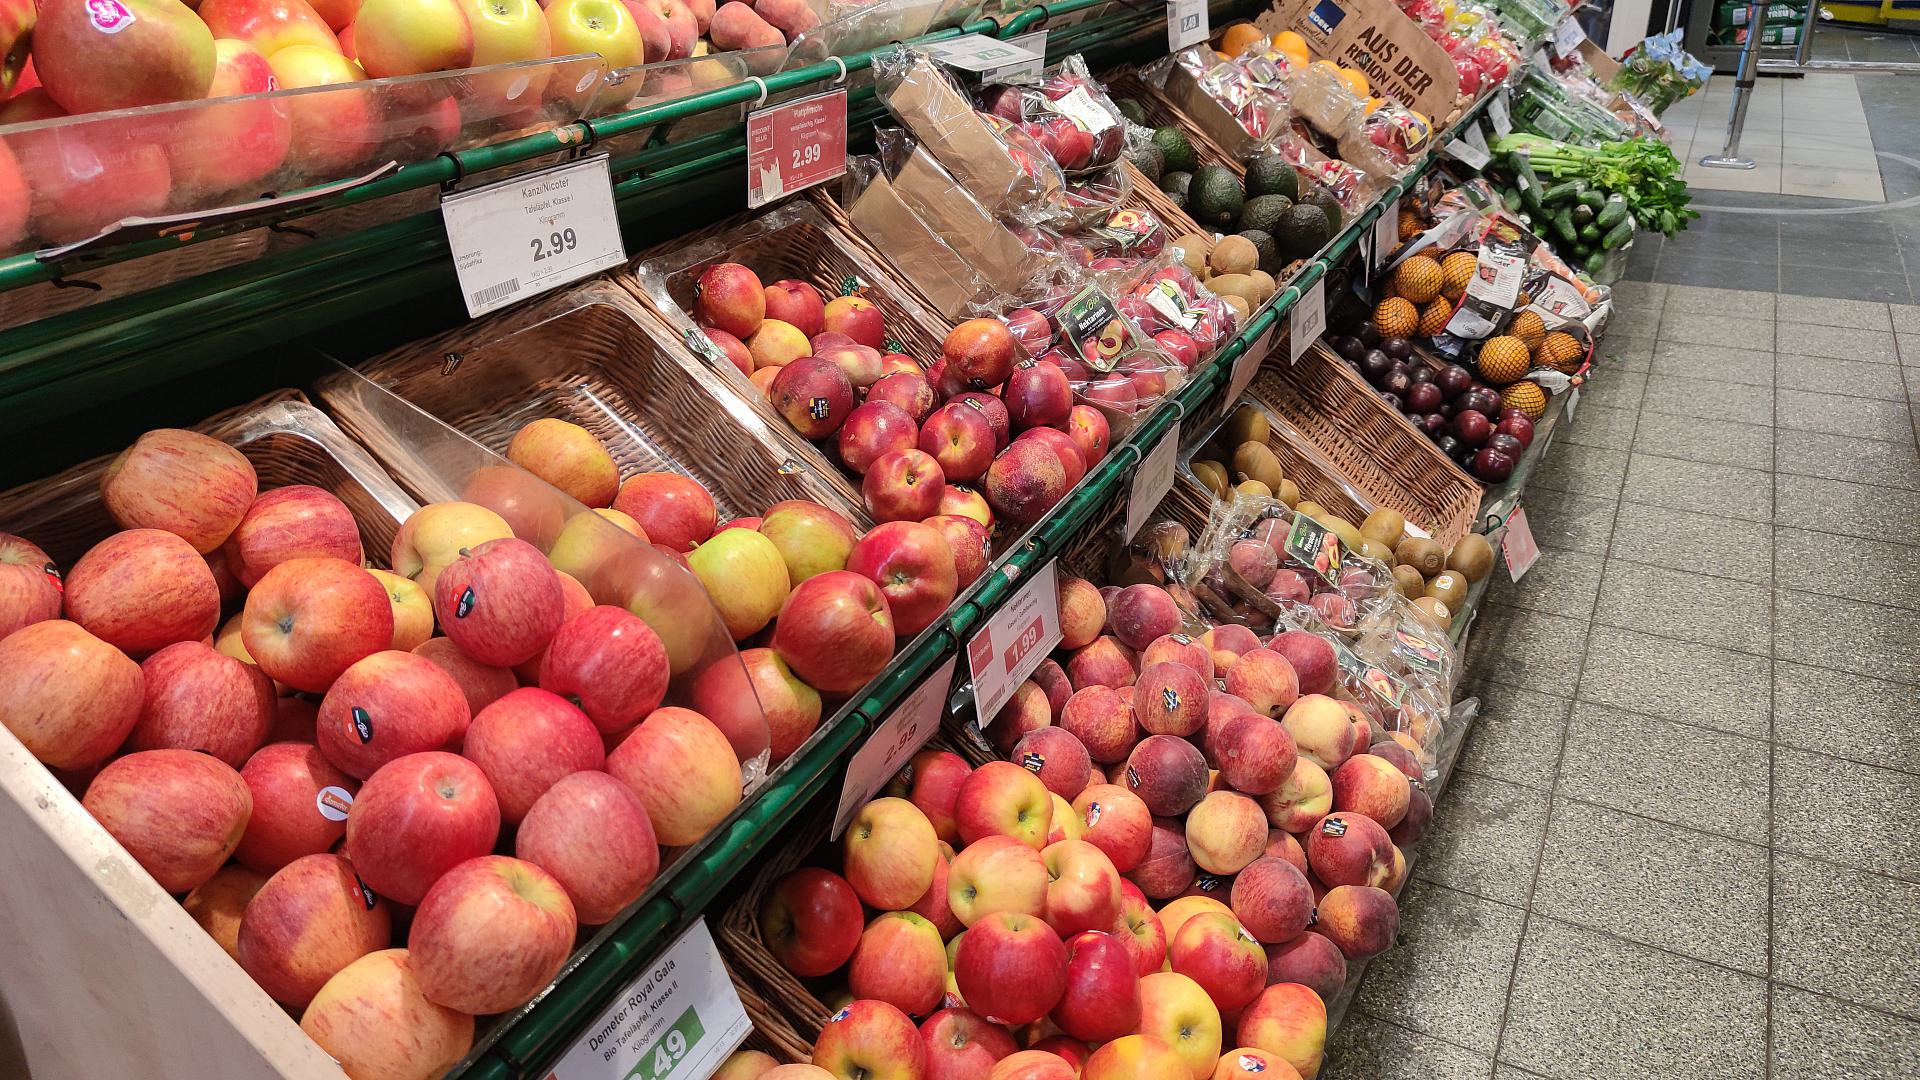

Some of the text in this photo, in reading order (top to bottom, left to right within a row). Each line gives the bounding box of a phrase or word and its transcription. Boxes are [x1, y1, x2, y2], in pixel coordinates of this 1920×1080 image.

[1345, 42, 1391, 86] REION
[1387, 81, 1415, 109] UND
[1357, 26, 1399, 63] AUS
[1393, 55, 1433, 96] DER
[792, 143, 821, 169] 2.99
[521, 177, 570, 199] Kanzi/Nicoter
[530, 227, 577, 262] 2.99
[1078, 306, 1107, 331] Nektarinen
[1012, 626, 1037, 662] 1.99
[357, 722, 369, 738] Bio
[884, 723, 918, 765] 2.99
[588, 959, 676, 1052] Demeter Royal Gala
[603, 980, 679, 1062] Bio Tafeläpfel, Klasse II
[632, 1016, 666, 1054] Kilogramm
